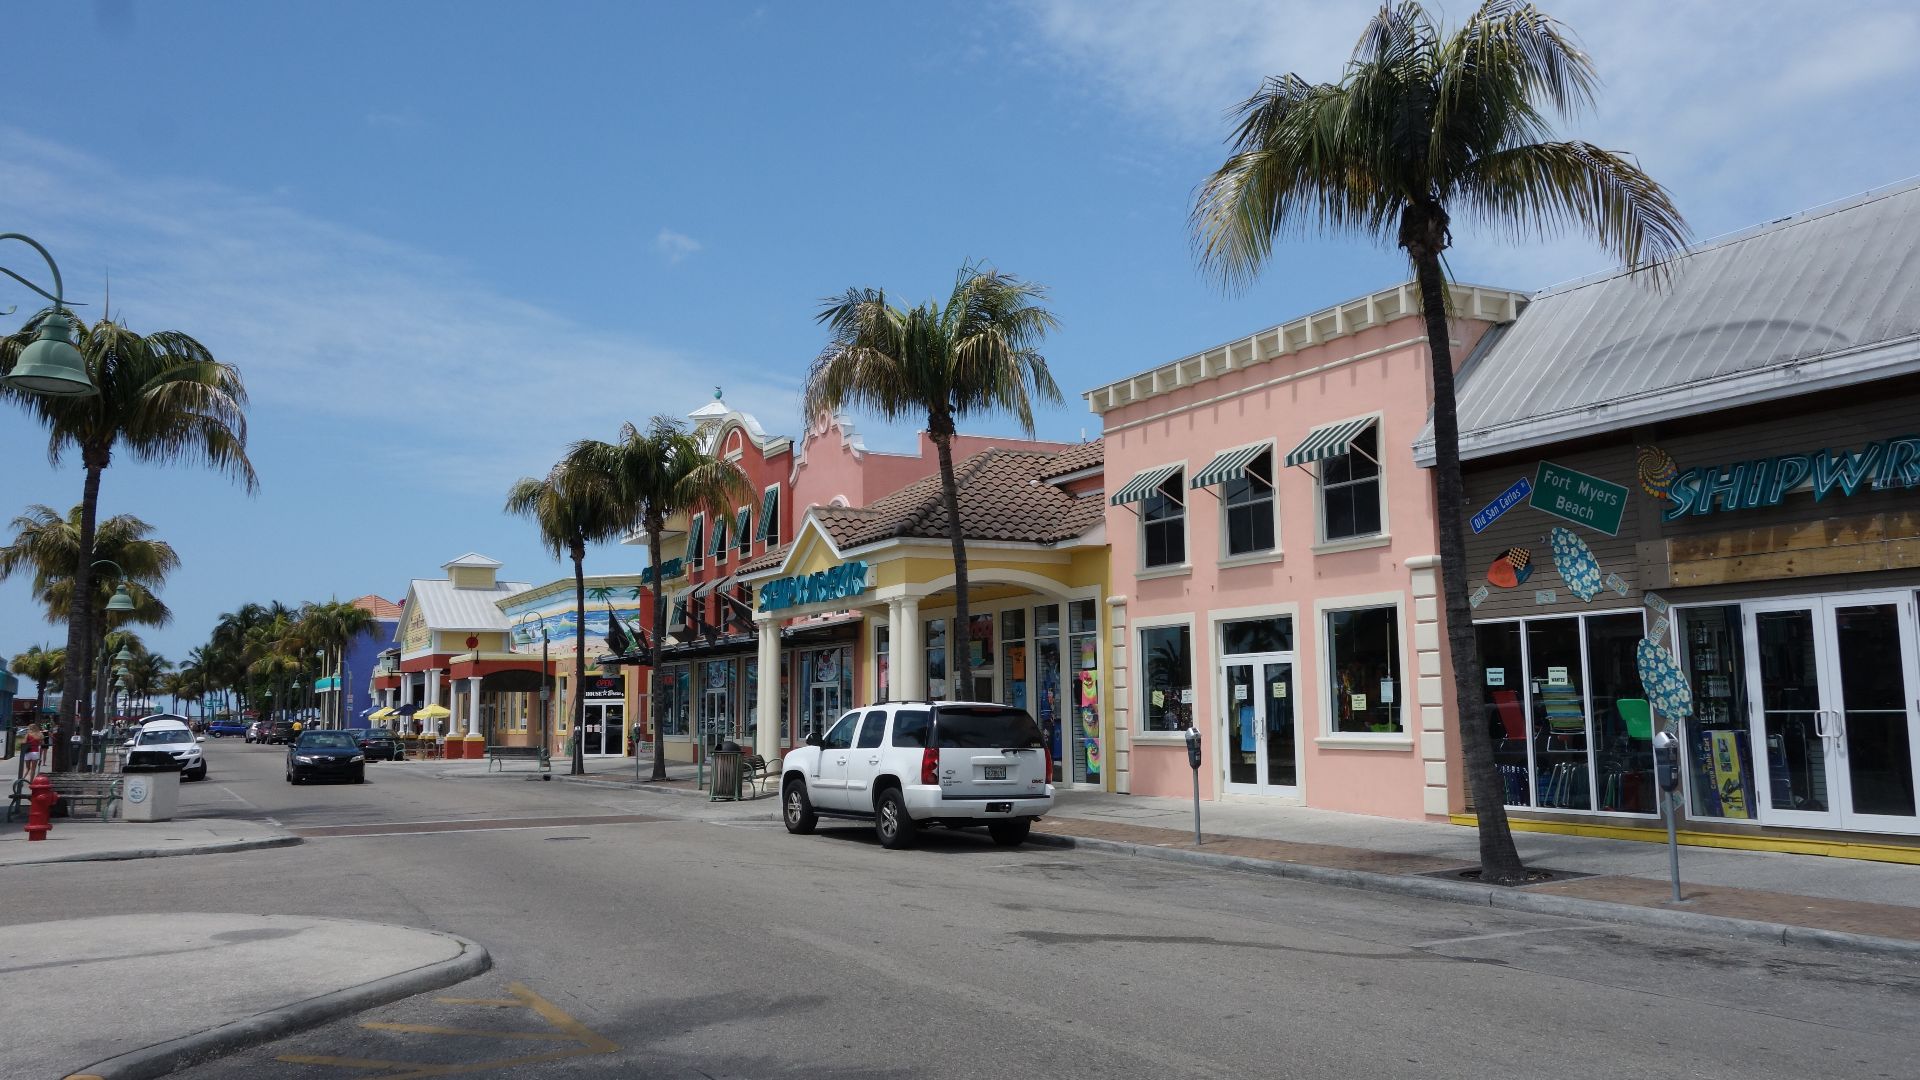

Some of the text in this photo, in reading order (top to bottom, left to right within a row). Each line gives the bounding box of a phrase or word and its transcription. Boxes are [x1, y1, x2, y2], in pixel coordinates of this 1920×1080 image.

[1544, 470, 1618, 506] Fort Myers
[1474, 513, 1488, 530] Old
[1486, 503, 1500, 520] San
[1499, 489, 1521, 510] Carlos
[1555, 496, 1594, 520] Beach
[596, 679, 614, 687] OPEN
[1702, 737, 1717, 789] Cargo Table Cart
